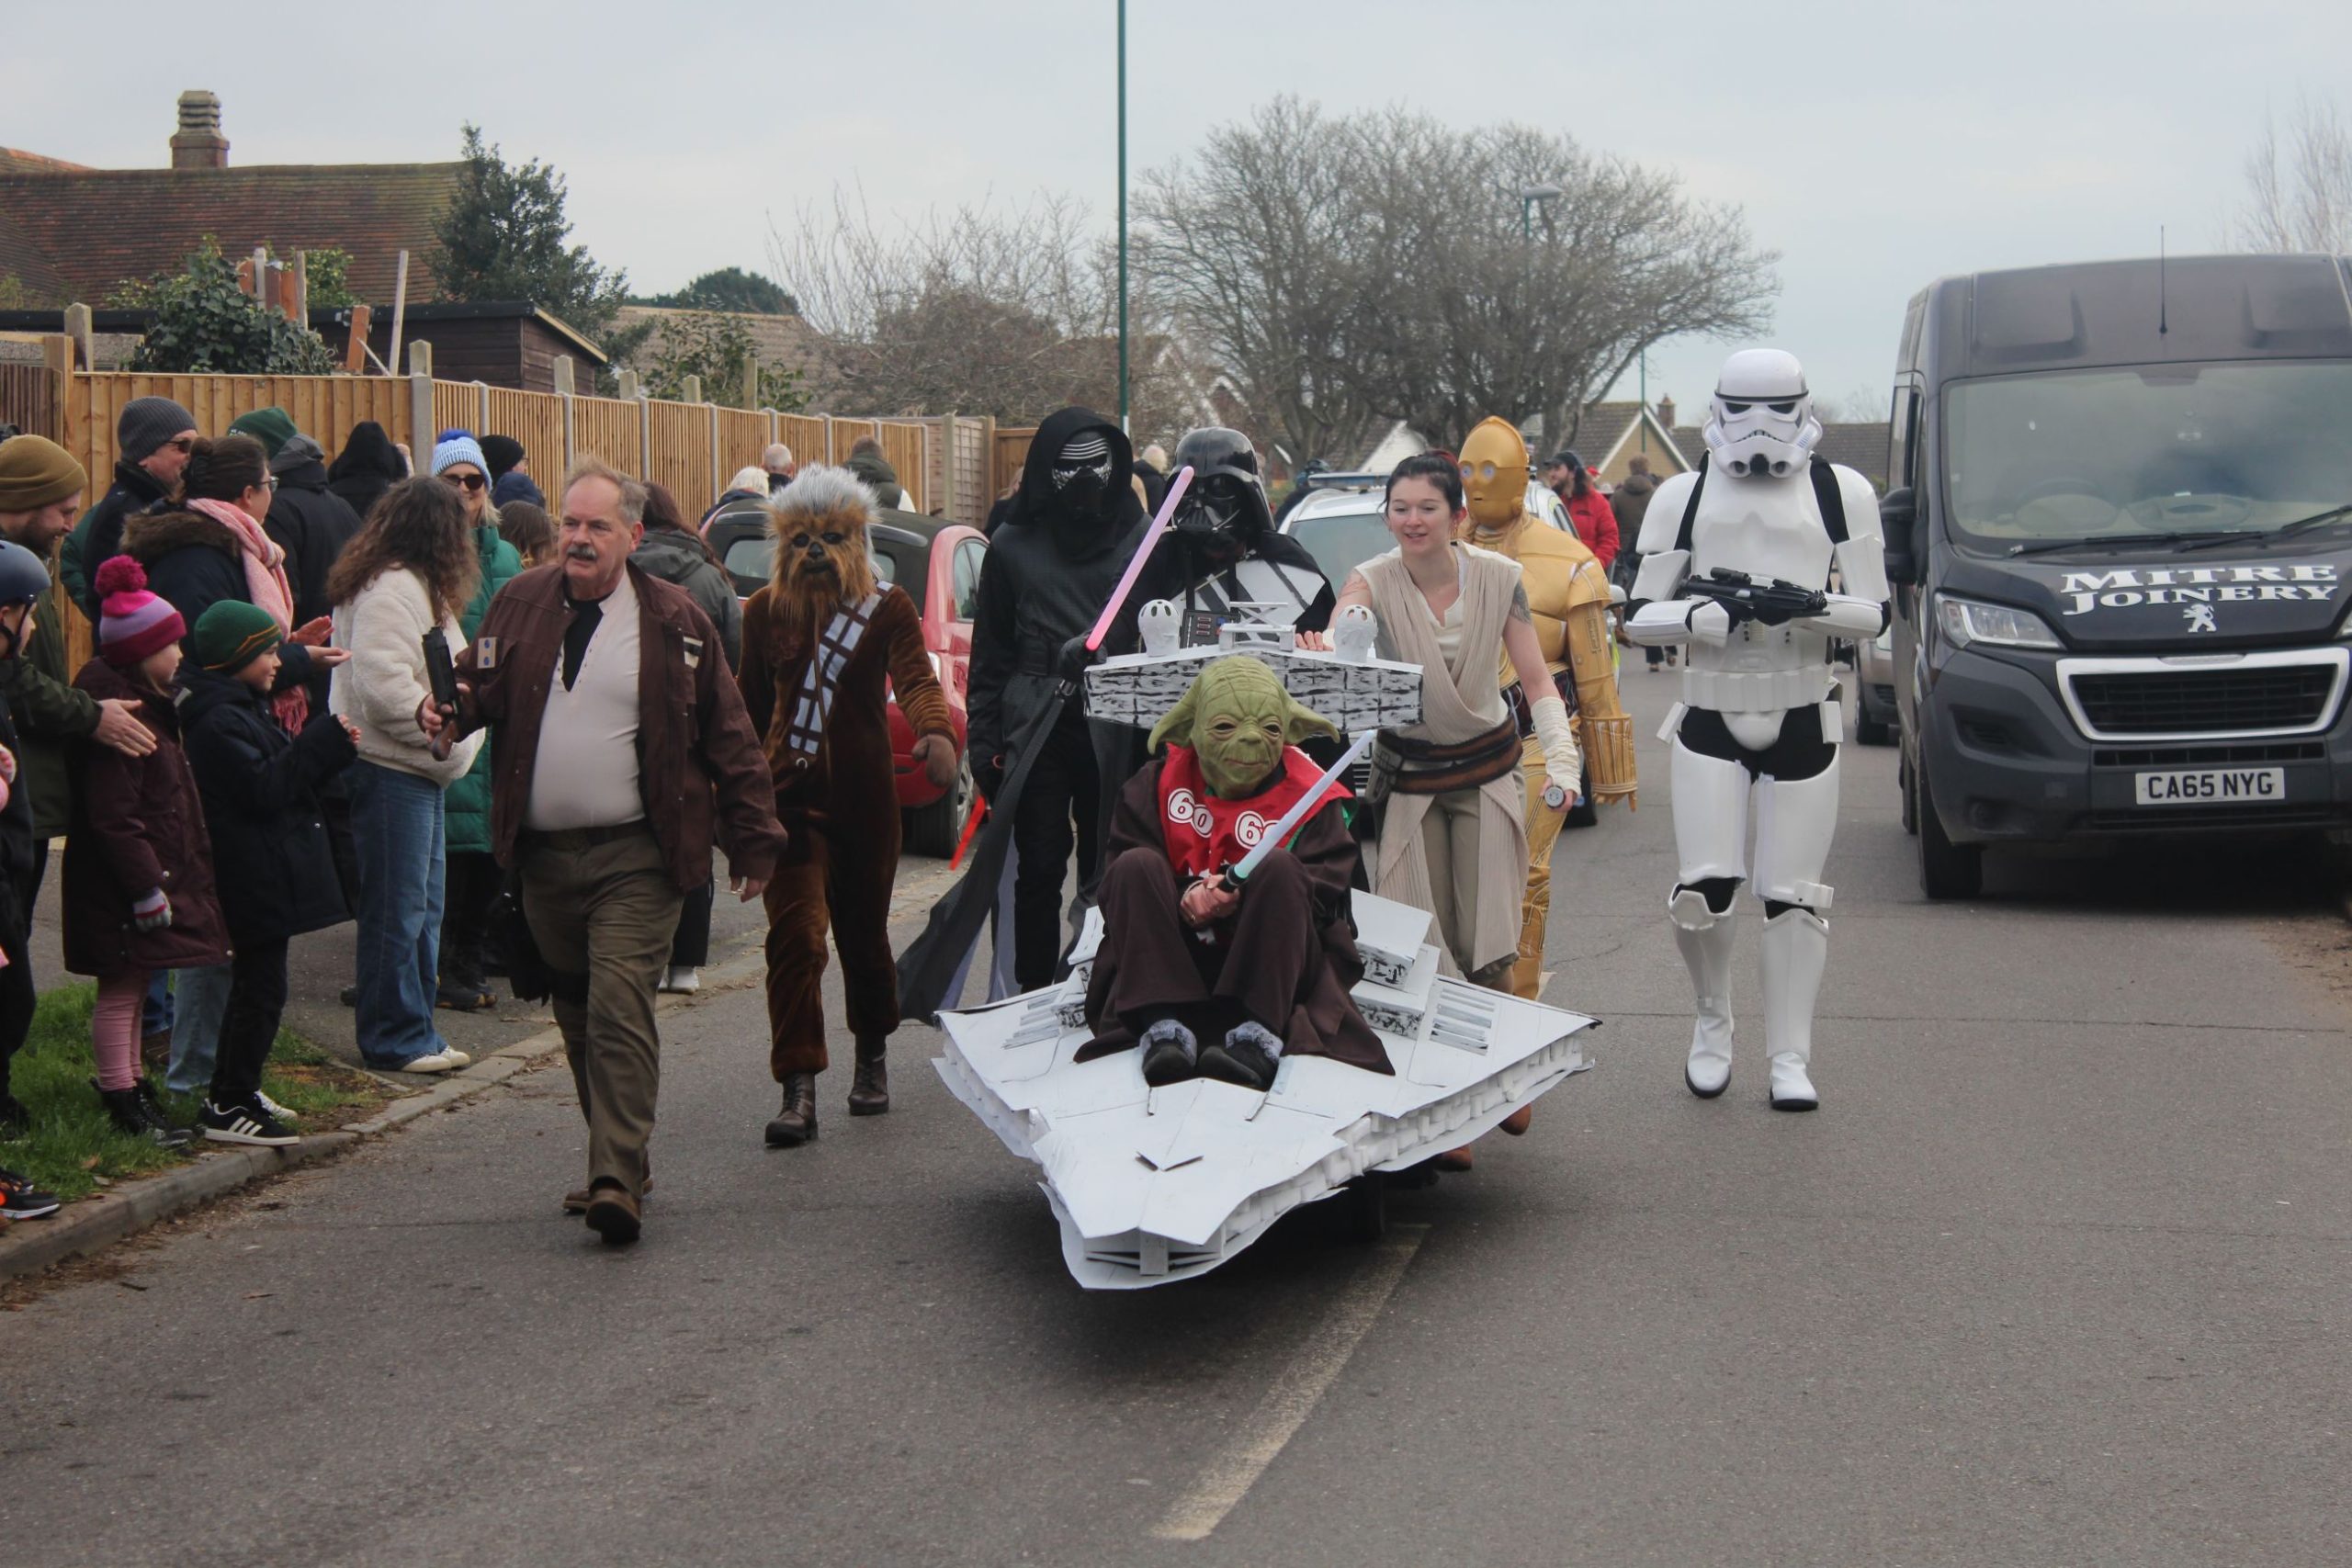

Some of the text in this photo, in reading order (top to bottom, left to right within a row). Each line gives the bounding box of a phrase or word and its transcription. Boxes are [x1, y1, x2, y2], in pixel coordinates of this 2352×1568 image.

[2061, 565, 2337, 593] MITRE
[2063, 585, 2338, 615] JOINERY
[2148, 772, 2274, 799] CA65 NYG
[1168, 788, 1214, 838] 60
[1235, 810, 1282, 850] 6
